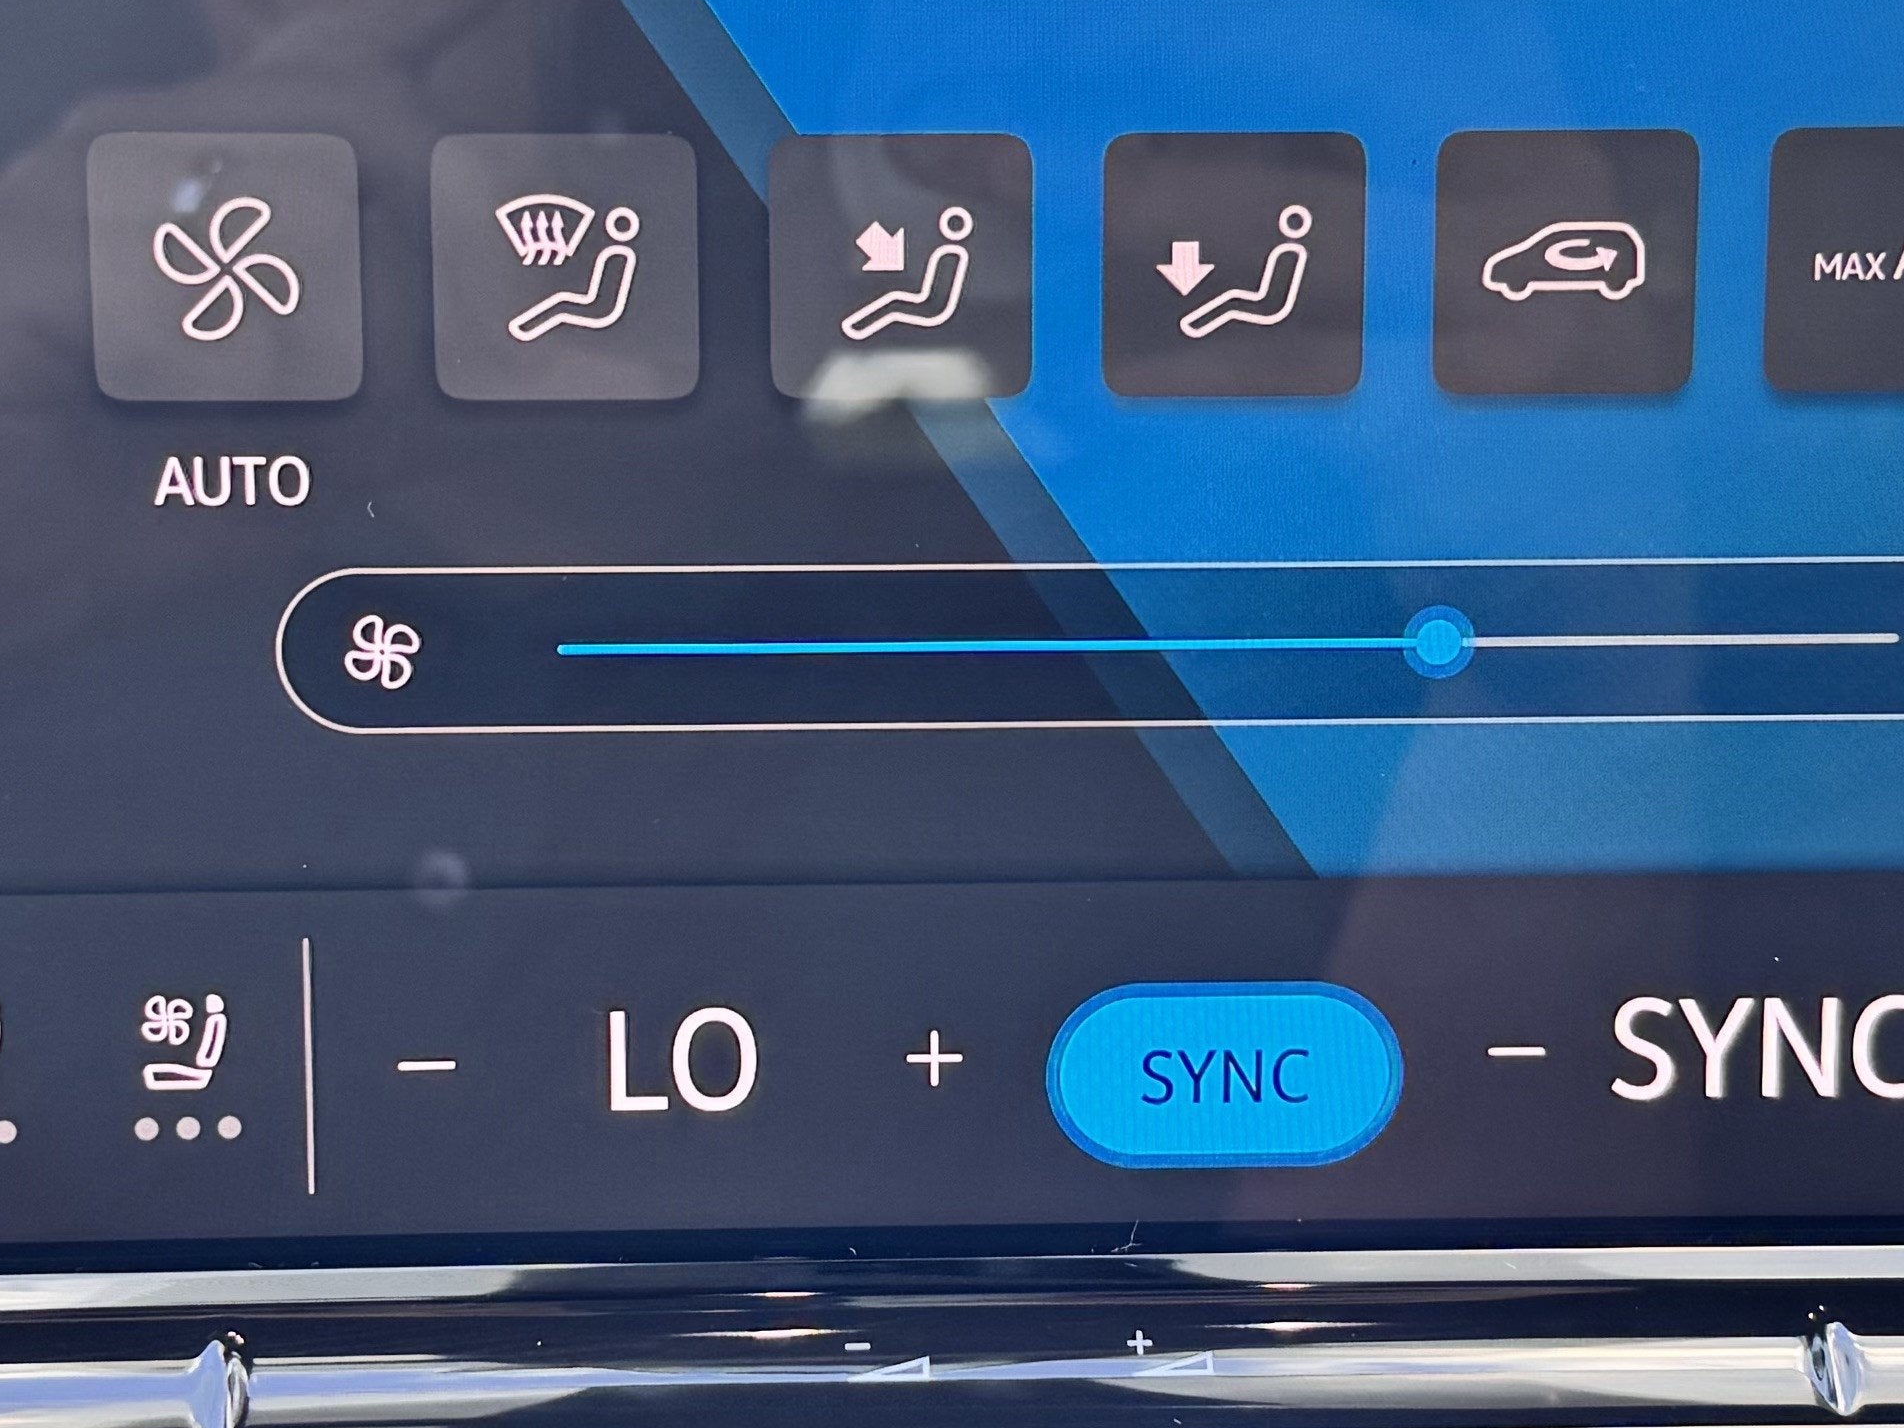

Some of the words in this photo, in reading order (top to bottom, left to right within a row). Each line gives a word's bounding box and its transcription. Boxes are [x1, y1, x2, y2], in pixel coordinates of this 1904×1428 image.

[1815, 253, 1886, 280] MAX
[155, 456, 309, 506] AUTO
[610, 1008, 756, 1111] LO
[1142, 1050, 1308, 1104] SYNC
